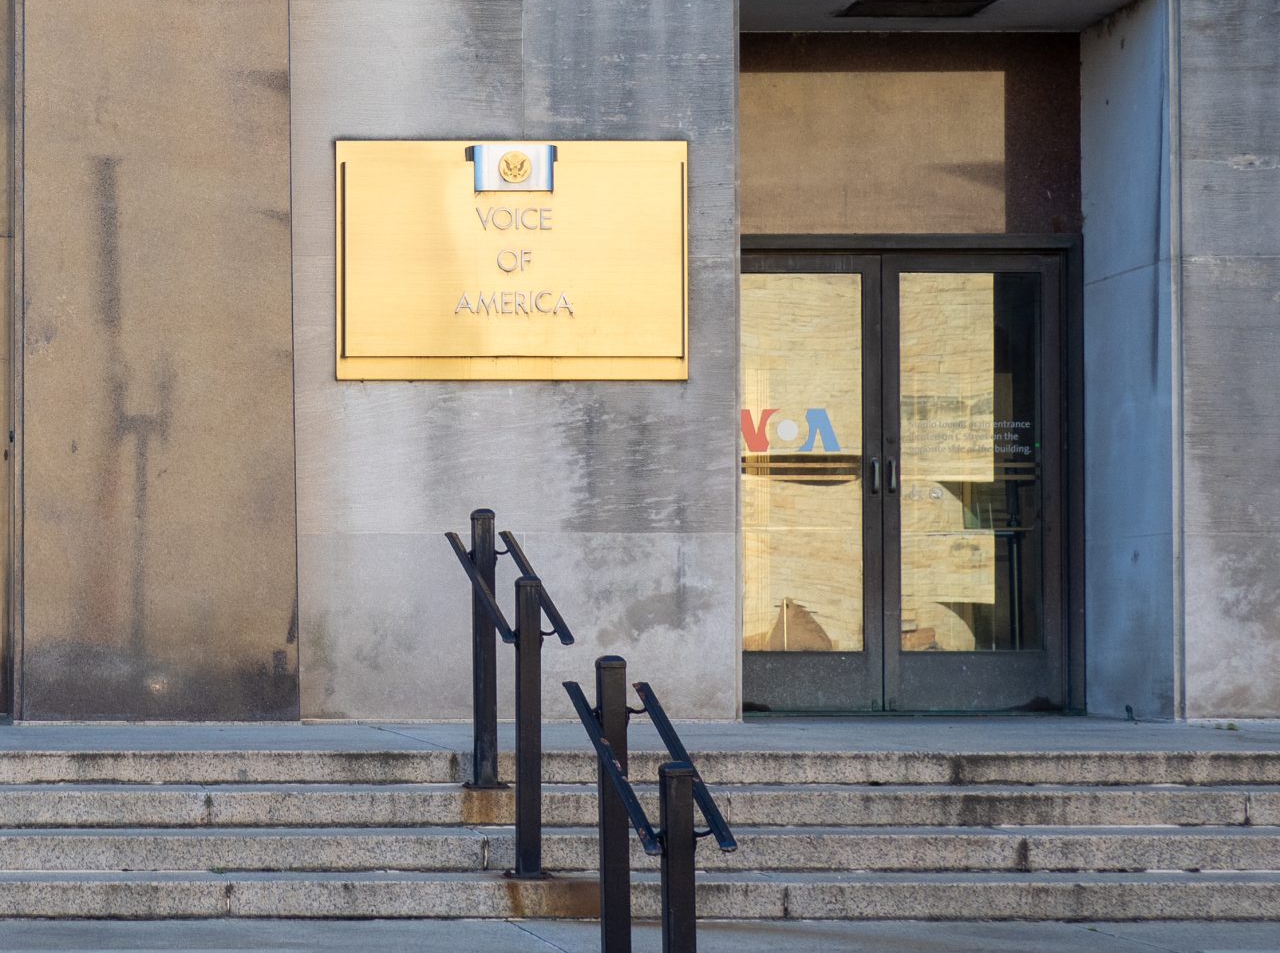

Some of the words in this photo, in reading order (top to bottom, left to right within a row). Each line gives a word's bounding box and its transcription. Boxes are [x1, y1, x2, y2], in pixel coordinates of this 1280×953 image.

[475, 207, 553, 231] VOICE
[496, 249, 532, 273] OF
[454, 290, 574, 317] AMERICA
[740, 409, 841, 453] VOA
[993, 420, 1031, 429] entrance
[1004, 431, 1020, 441] the
[994, 444, 1033, 456] building.
